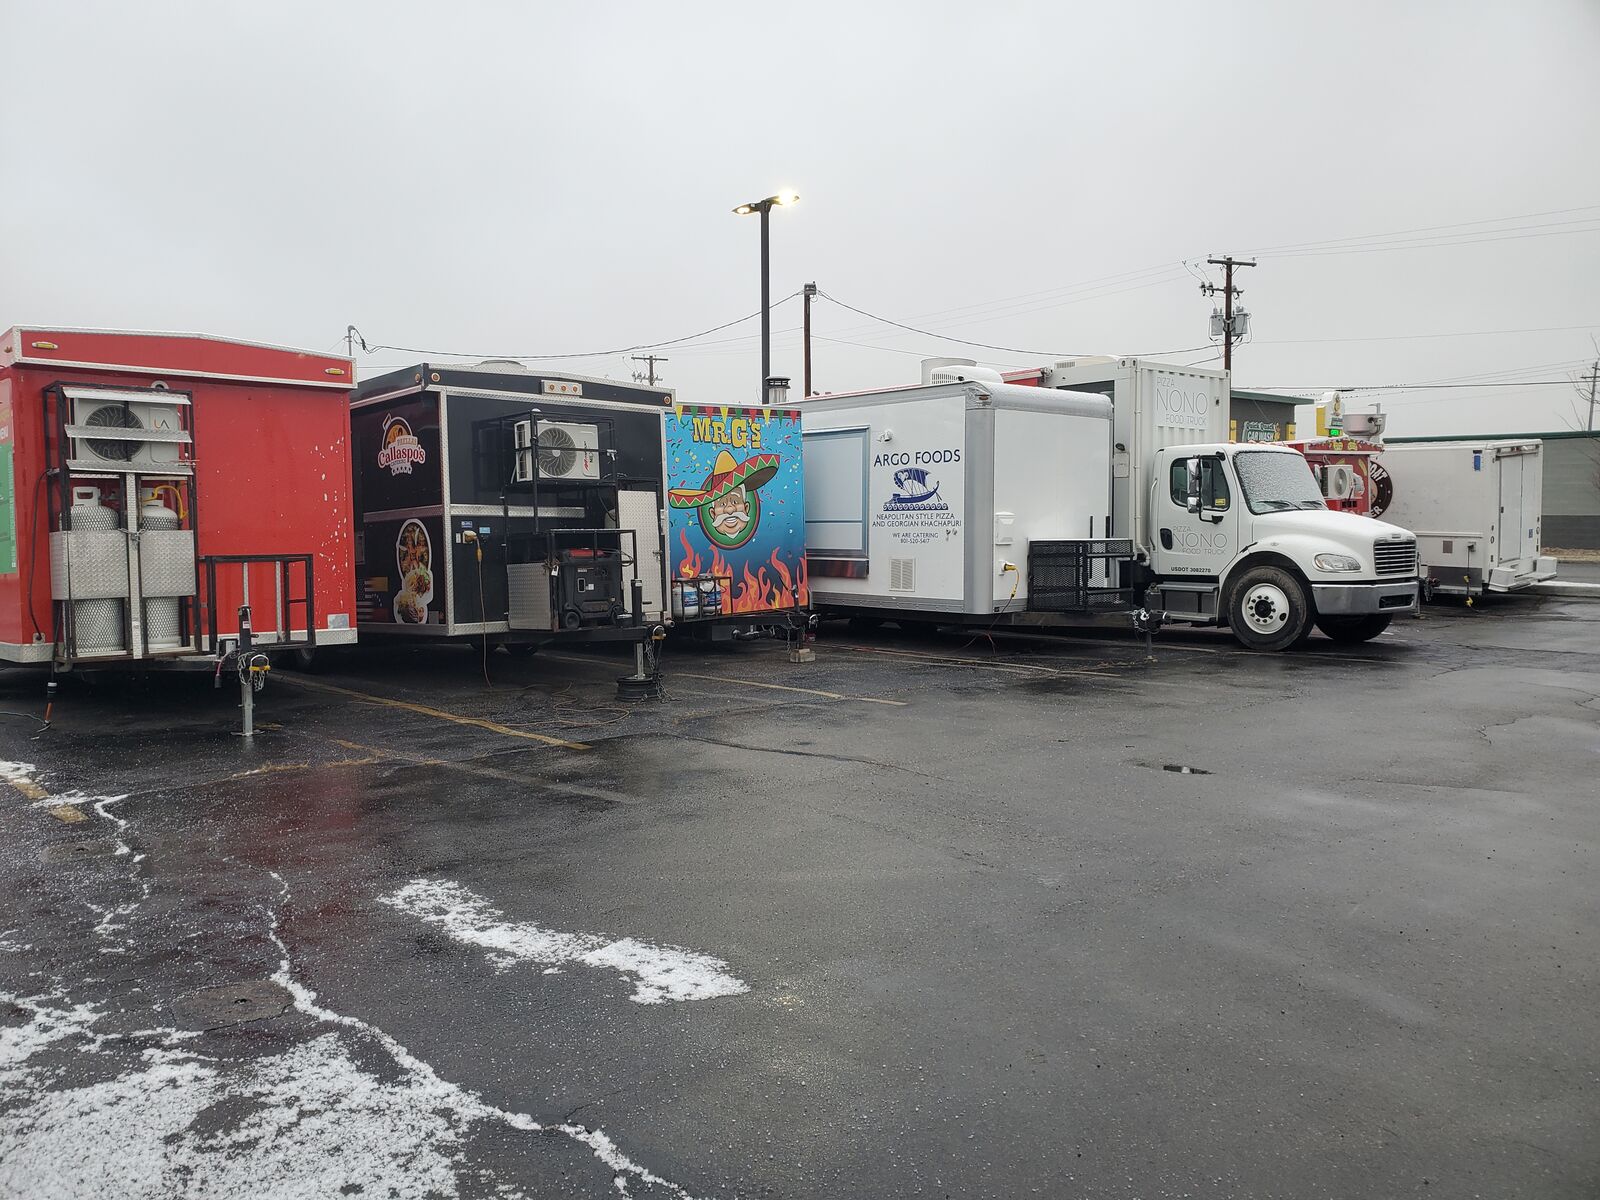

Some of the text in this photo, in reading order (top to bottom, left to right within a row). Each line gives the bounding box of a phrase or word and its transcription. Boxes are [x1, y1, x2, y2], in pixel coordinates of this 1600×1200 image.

[1156, 388, 1207, 415] NONO
[1165, 413, 1207, 426] FOOD TRUCK
[379, 446, 425, 467] Callaspo's
[874, 449, 961, 467] ARGO FOODS
[1172, 532, 1227, 548] NONO
